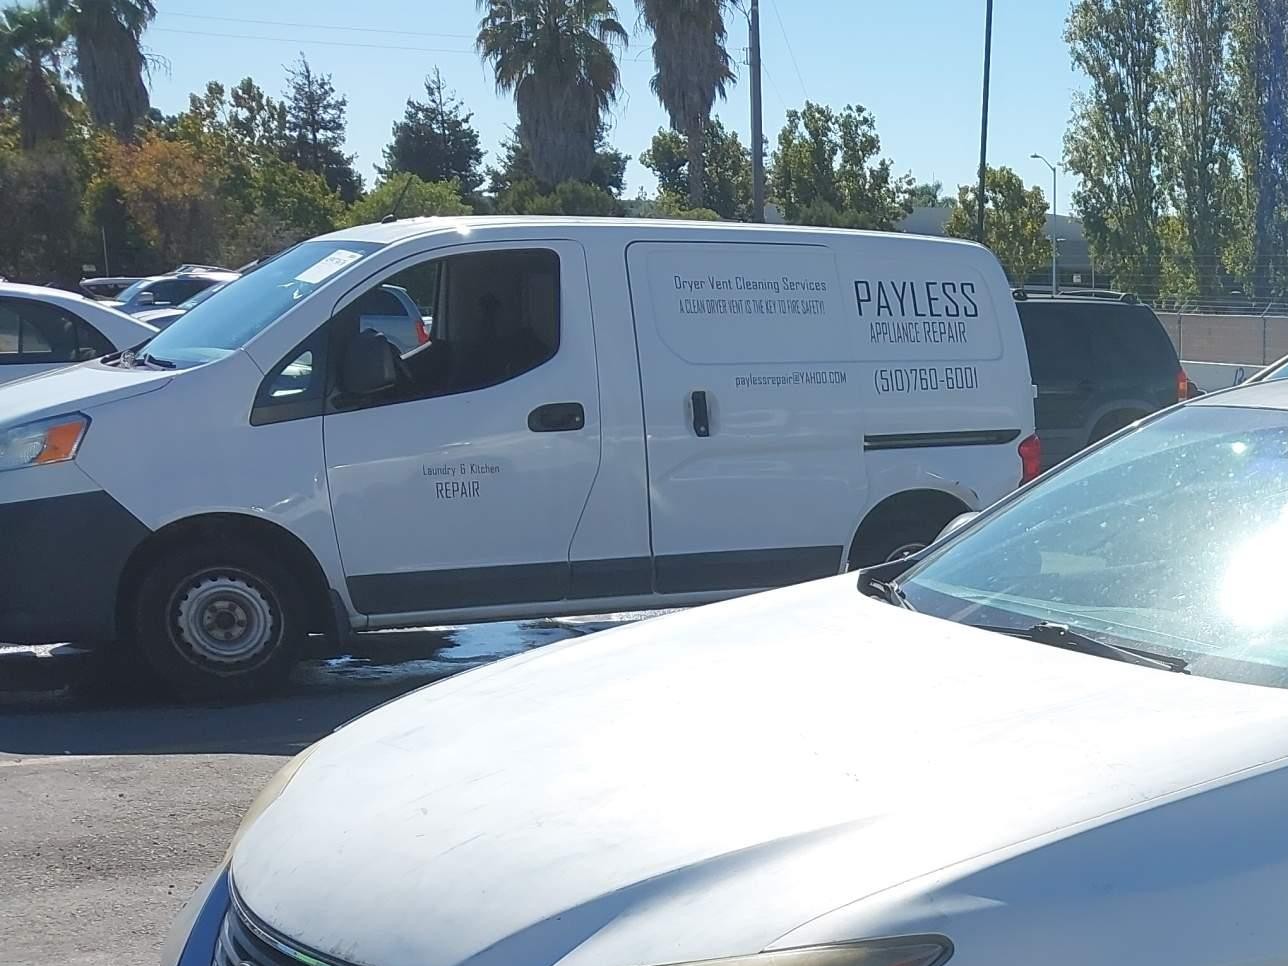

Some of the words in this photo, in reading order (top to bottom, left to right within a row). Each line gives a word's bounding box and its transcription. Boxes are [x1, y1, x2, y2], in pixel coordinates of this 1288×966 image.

[674, 276, 705, 292] Dryer
[708, 276, 732, 290] Vent
[735, 276, 780, 293] Cleaning
[782, 277, 827, 291] Services
[685, 299, 705, 314] CLEAN
[854, 280, 978, 318] PAYLESS
[870, 321, 920, 343] APPLIANCE
[923, 321, 967, 343] REPAIR
[874, 367, 978, 394] (510)760-6001
[422, 463, 456, 476] Laundry
[470, 463, 500, 474] Kitchen
[435, 481, 480, 499] REPAIR
